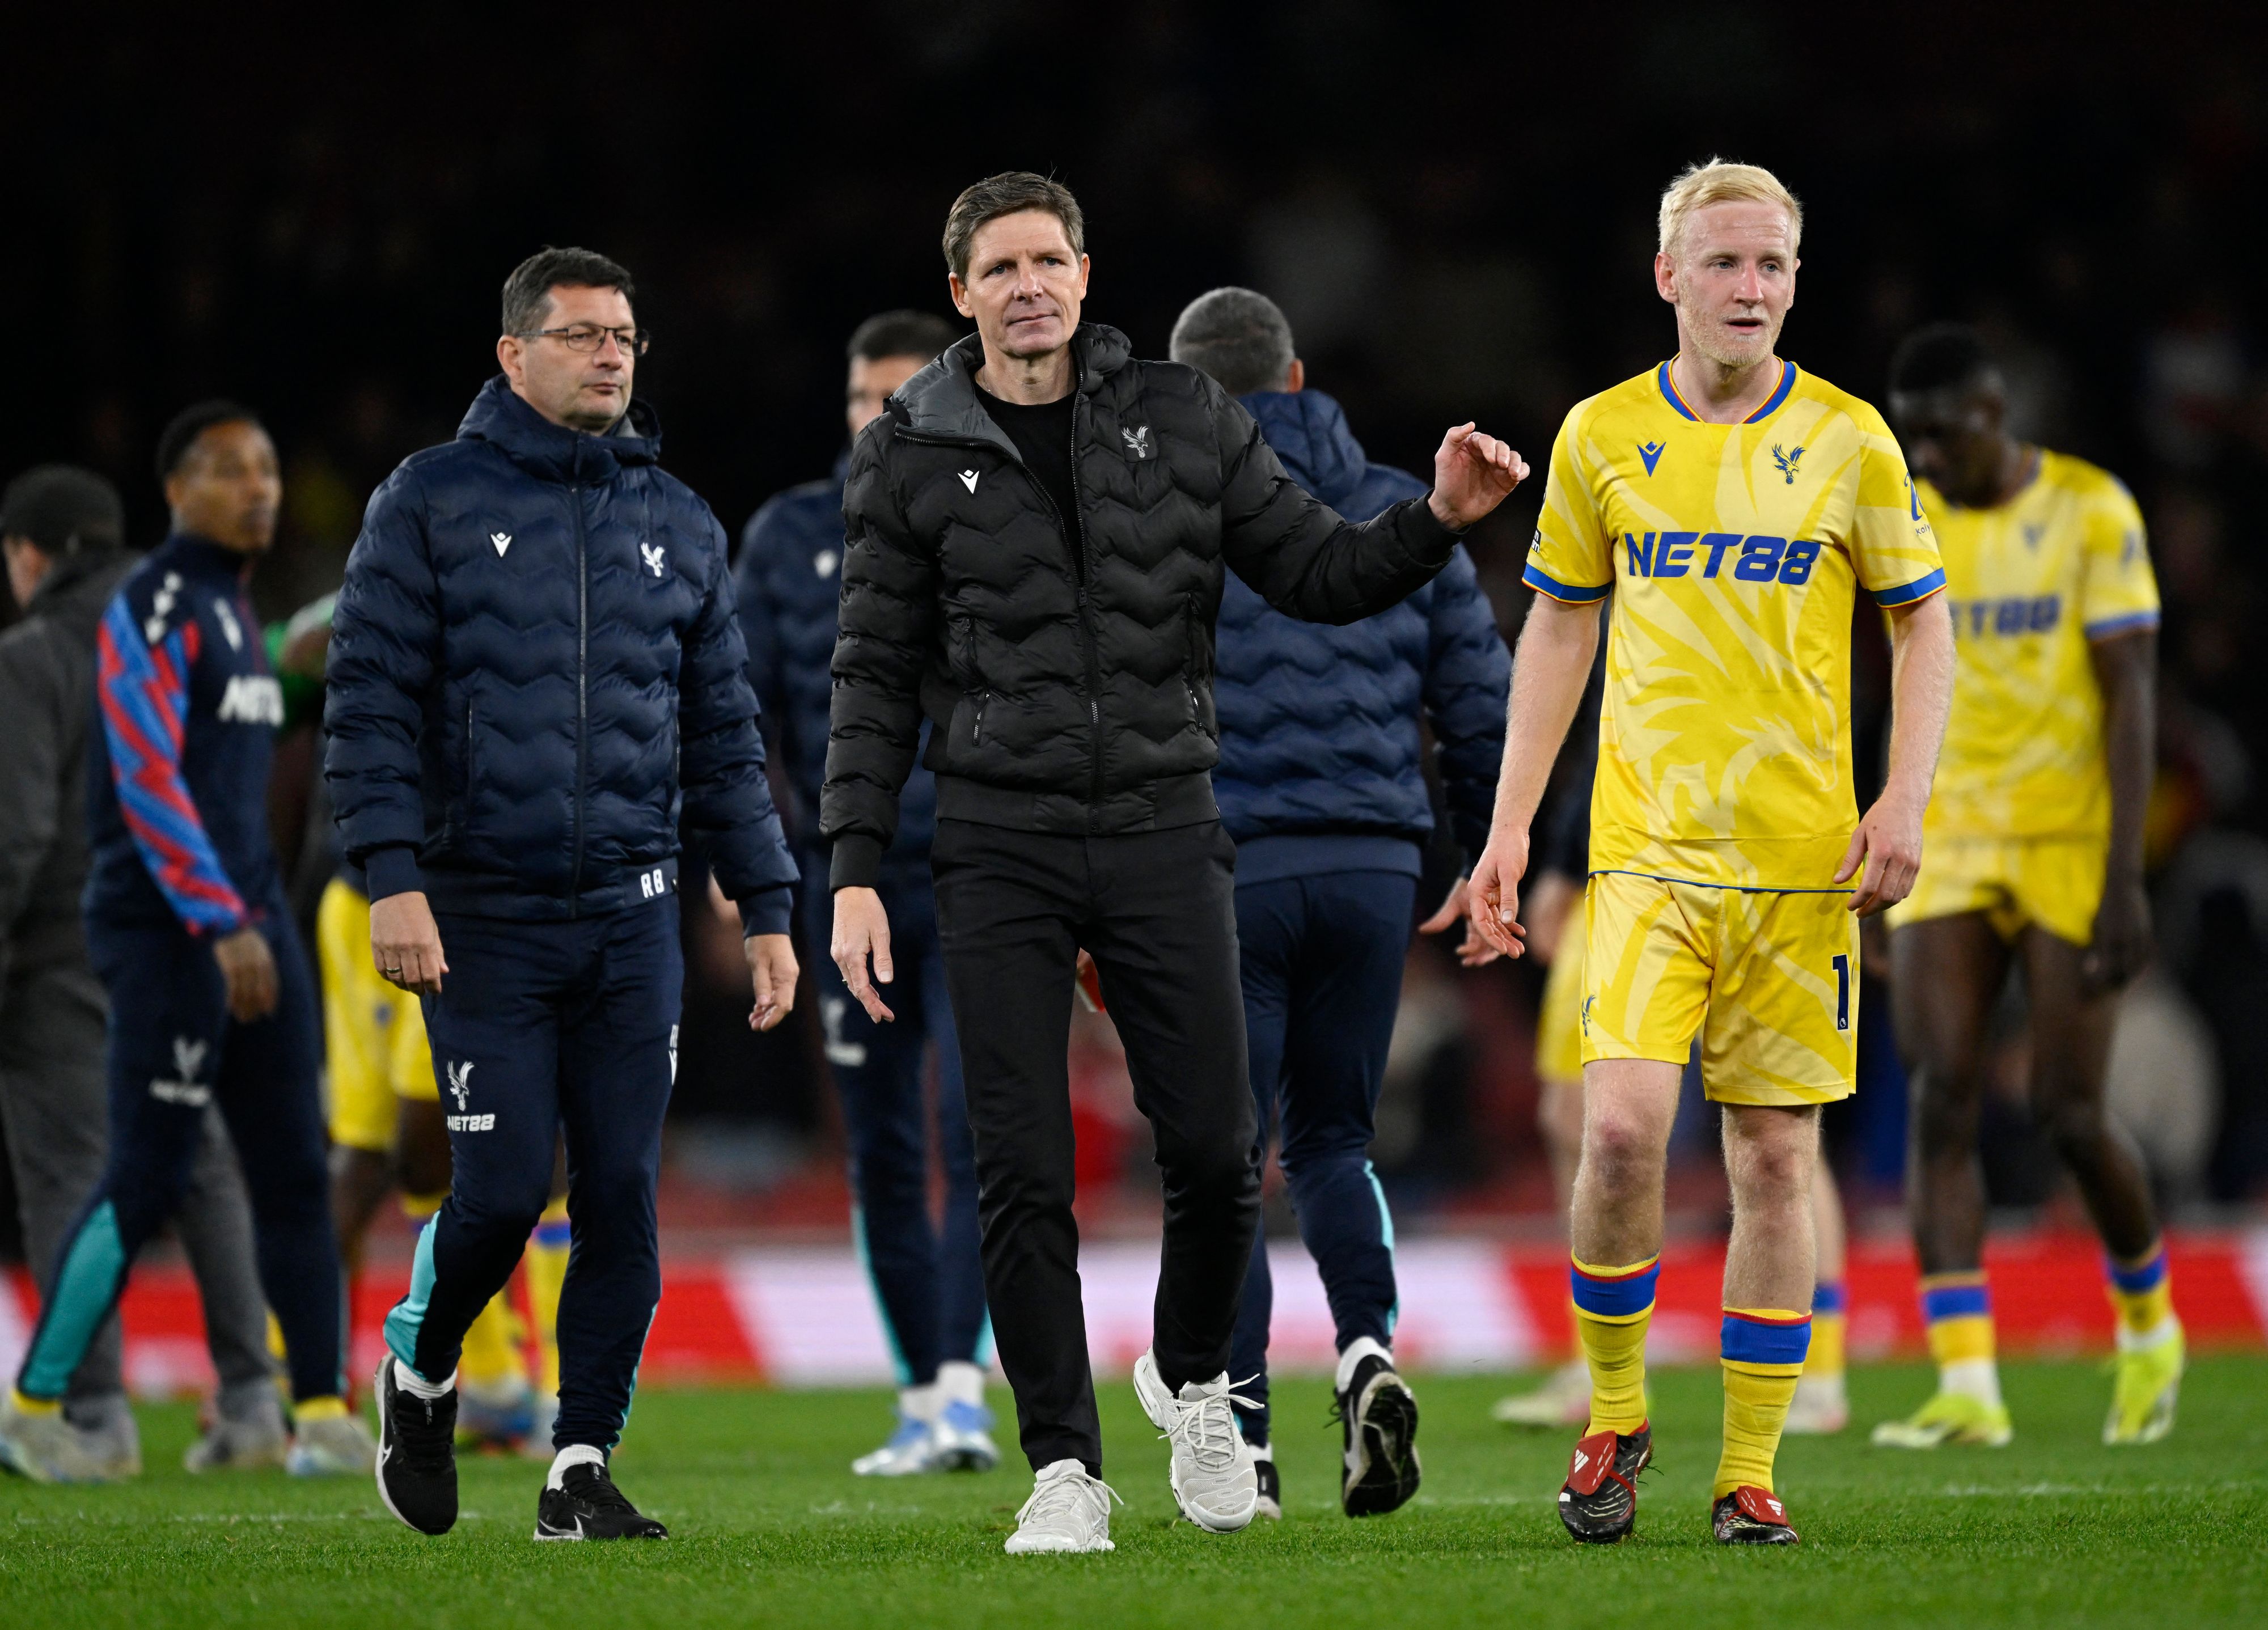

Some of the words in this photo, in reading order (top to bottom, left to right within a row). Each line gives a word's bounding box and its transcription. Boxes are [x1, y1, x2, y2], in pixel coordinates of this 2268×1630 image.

[1624, 532, 1821, 585] NET88
[641, 869, 665, 898] RB
[1832, 954, 1850, 1031] 1
[447, 1114, 495, 1132] NET88
